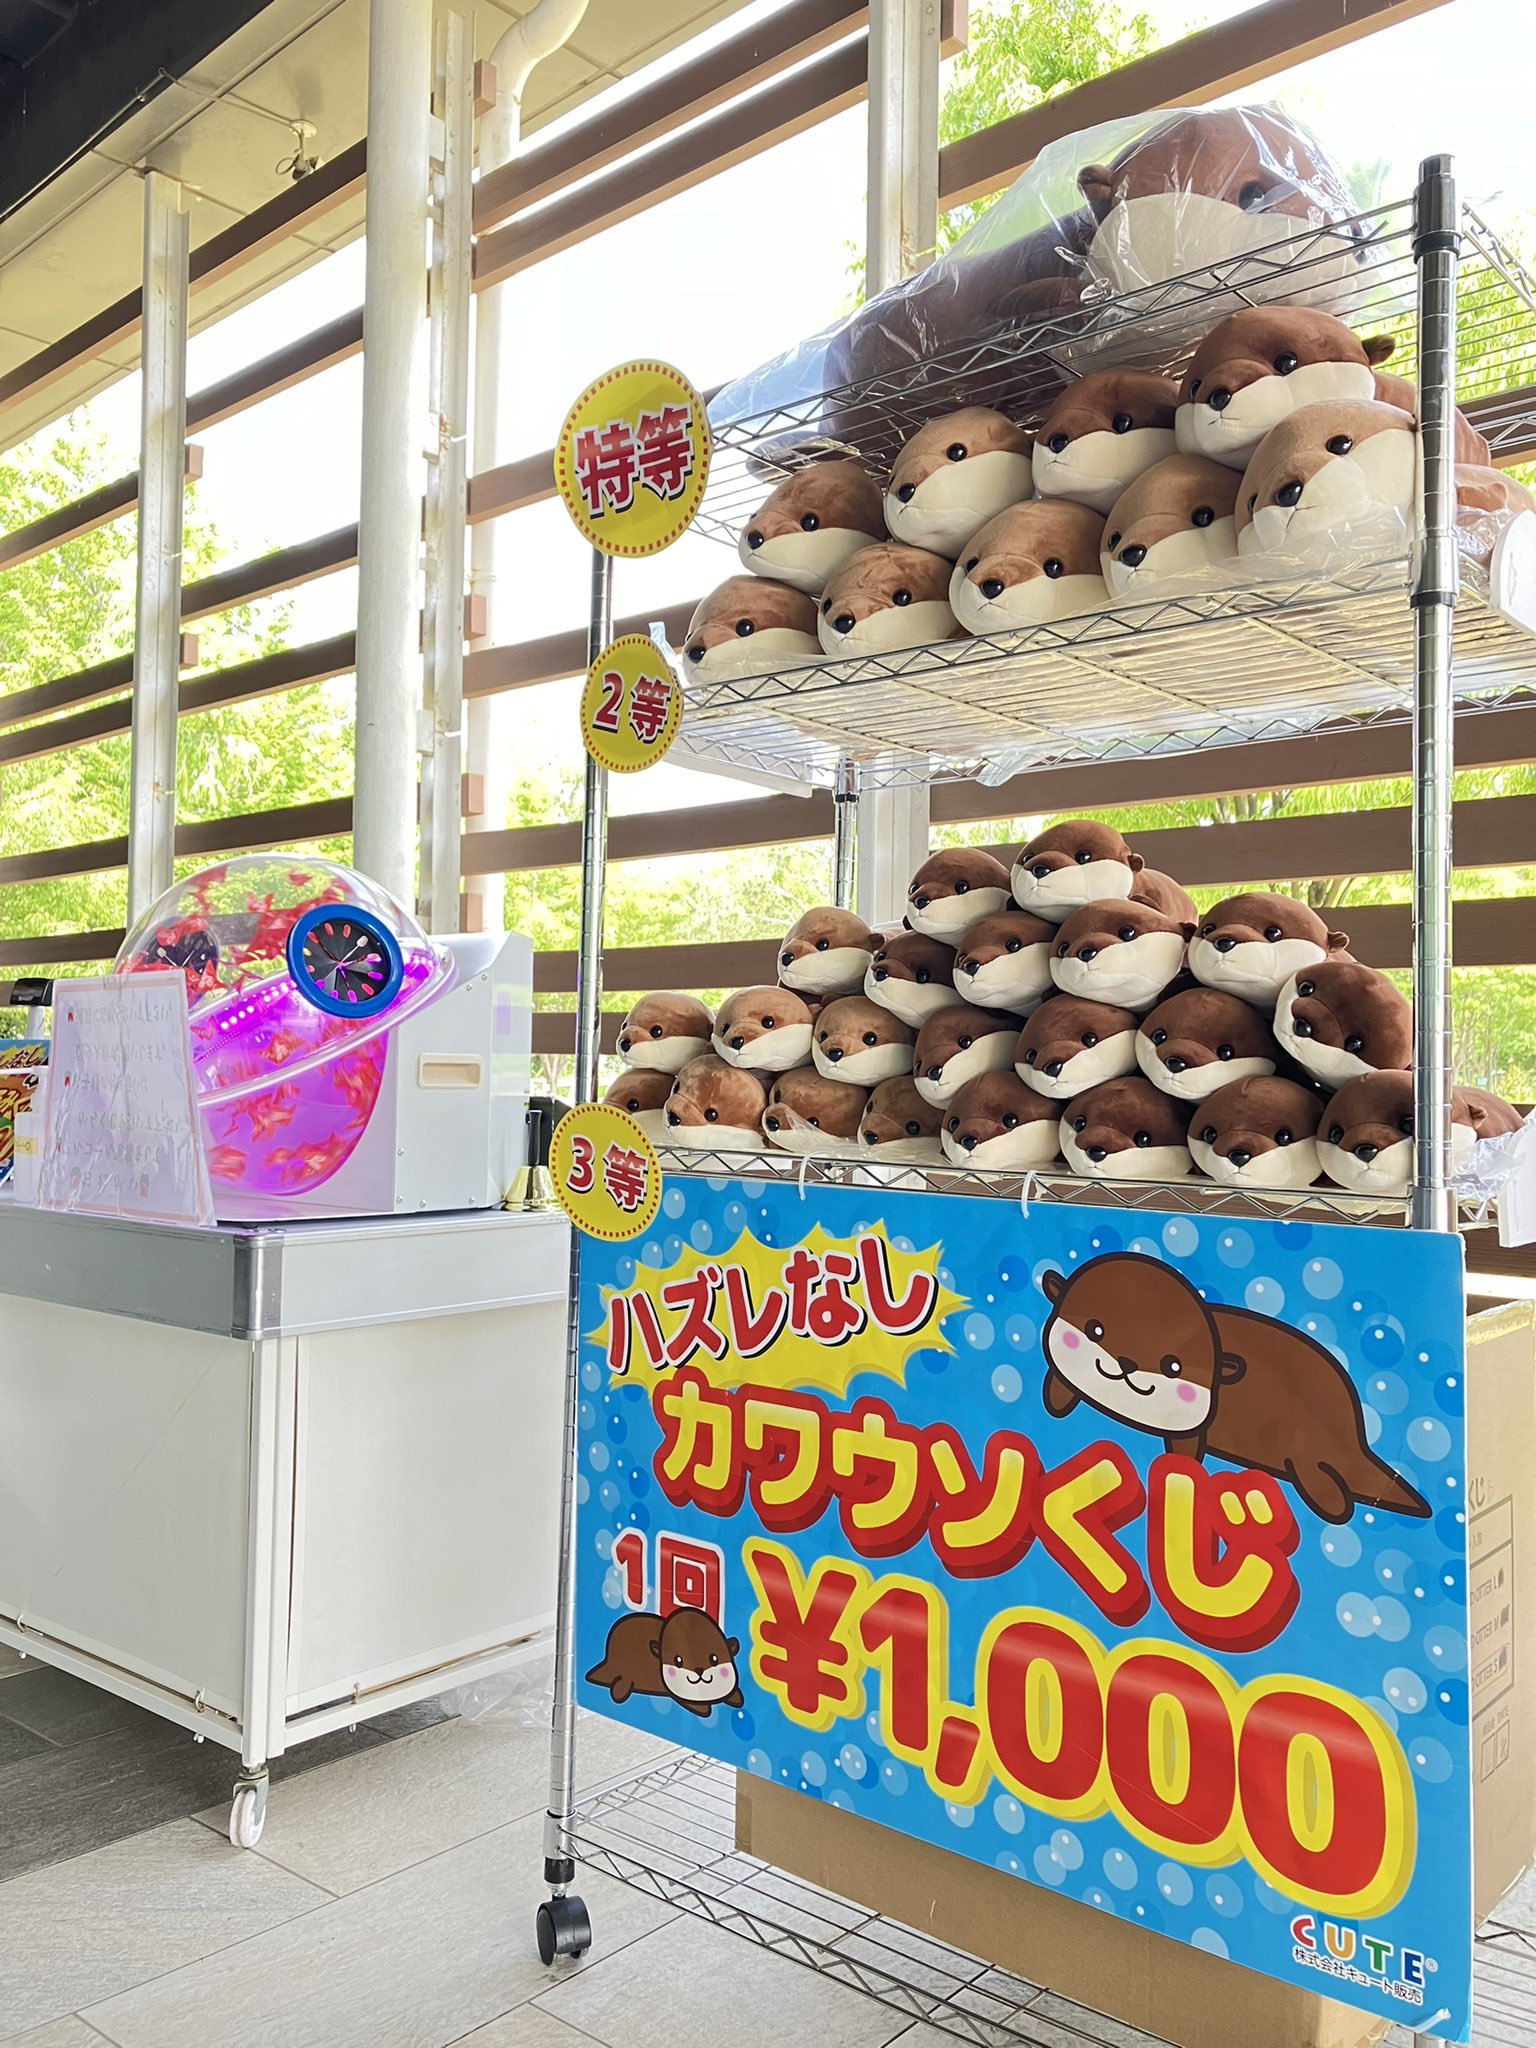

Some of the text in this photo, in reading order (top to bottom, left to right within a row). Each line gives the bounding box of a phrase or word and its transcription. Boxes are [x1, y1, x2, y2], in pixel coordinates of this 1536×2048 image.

[573, 403, 694, 519] 特等
[592, 669, 673, 744] 2等
[568, 1137, 651, 1214] 3等
[607, 1233, 938, 1375] ハズレなし
[656, 1374, 1298, 1648] カワウソくじ
[613, 1528, 727, 1624] 1回
[746, 1540, 1412, 1914] ¥1,000
[1291, 1915, 1426, 1988] CUTE
[1293, 1947, 1424, 2006] 株式会社キュート販売
